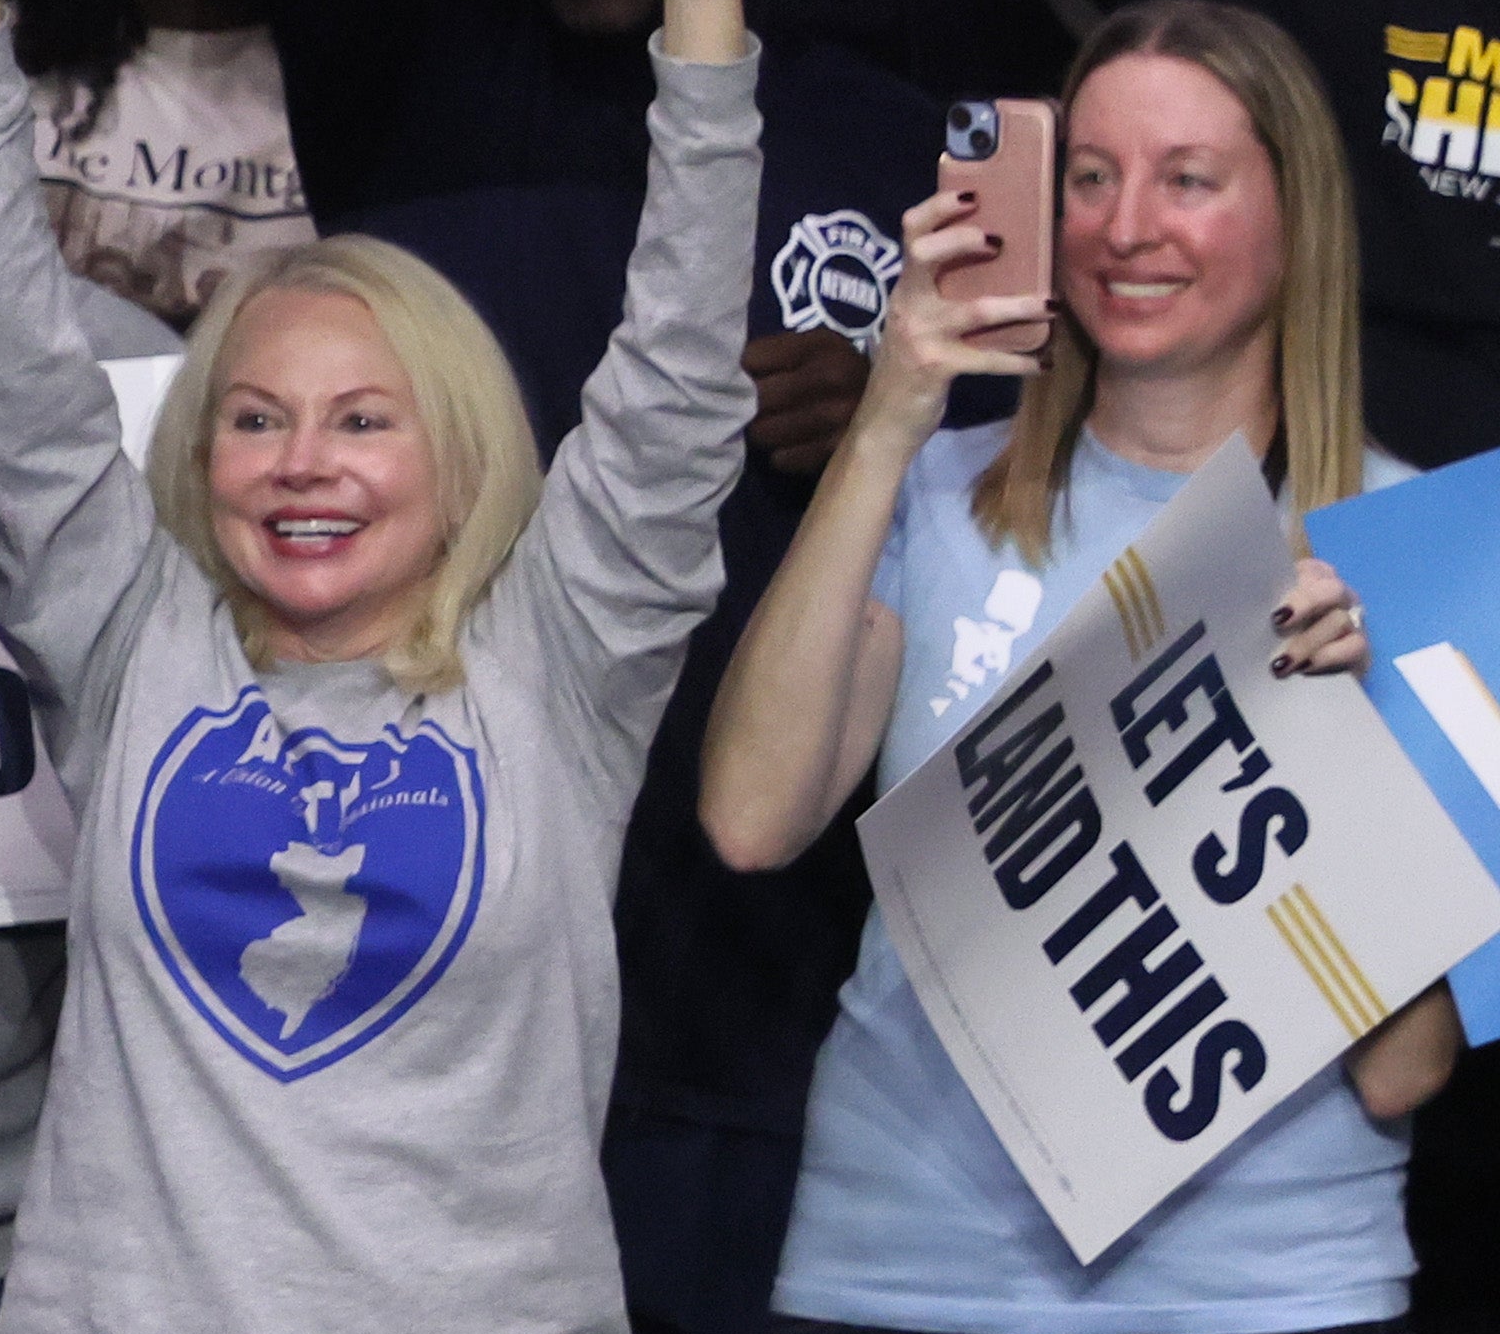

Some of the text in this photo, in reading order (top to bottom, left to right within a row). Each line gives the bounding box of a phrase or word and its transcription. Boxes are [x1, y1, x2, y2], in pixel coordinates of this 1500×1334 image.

[952, 659, 1103, 912] LAND
[1041, 840, 1268, 1143] THIS
[1107, 619, 1310, 905] LET'S
